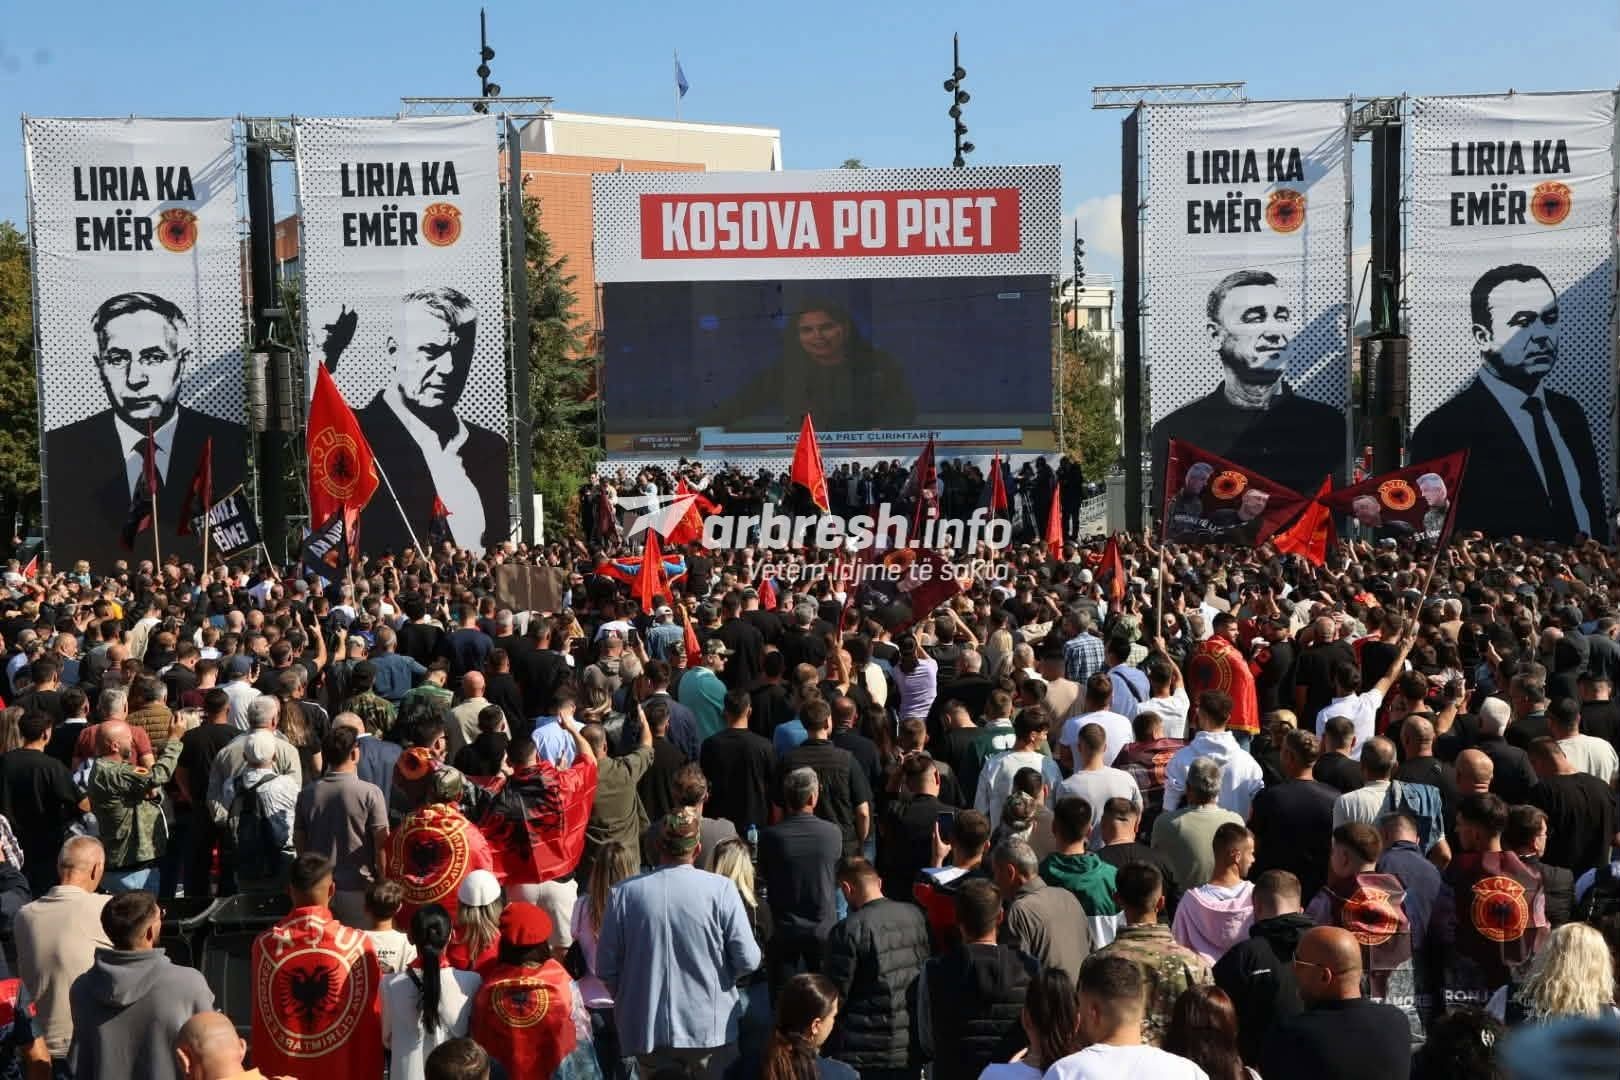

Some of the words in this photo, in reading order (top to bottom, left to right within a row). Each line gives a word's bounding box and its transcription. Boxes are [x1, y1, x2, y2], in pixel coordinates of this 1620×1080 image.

[341, 162, 415, 197] LIRIA
[421, 161, 460, 195] KA
[1187, 149, 1260, 184] LIRIA
[1267, 147, 1304, 182] KA
[1451, 140, 1525, 176] LIRIA
[1533, 139, 1571, 174] KA
[73, 166, 149, 201] LIRIA
[155, 166, 196, 201] KA
[1450, 183, 1526, 226] EMËR
[75, 208, 153, 251] EMËR
[342, 204, 418, 247] EMËR
[661, 200, 820, 252] KOSOVA
[833, 199, 886, 250] PO
[897, 196, 998, 249] PRET
[1187, 191, 1262, 234] EMËR
